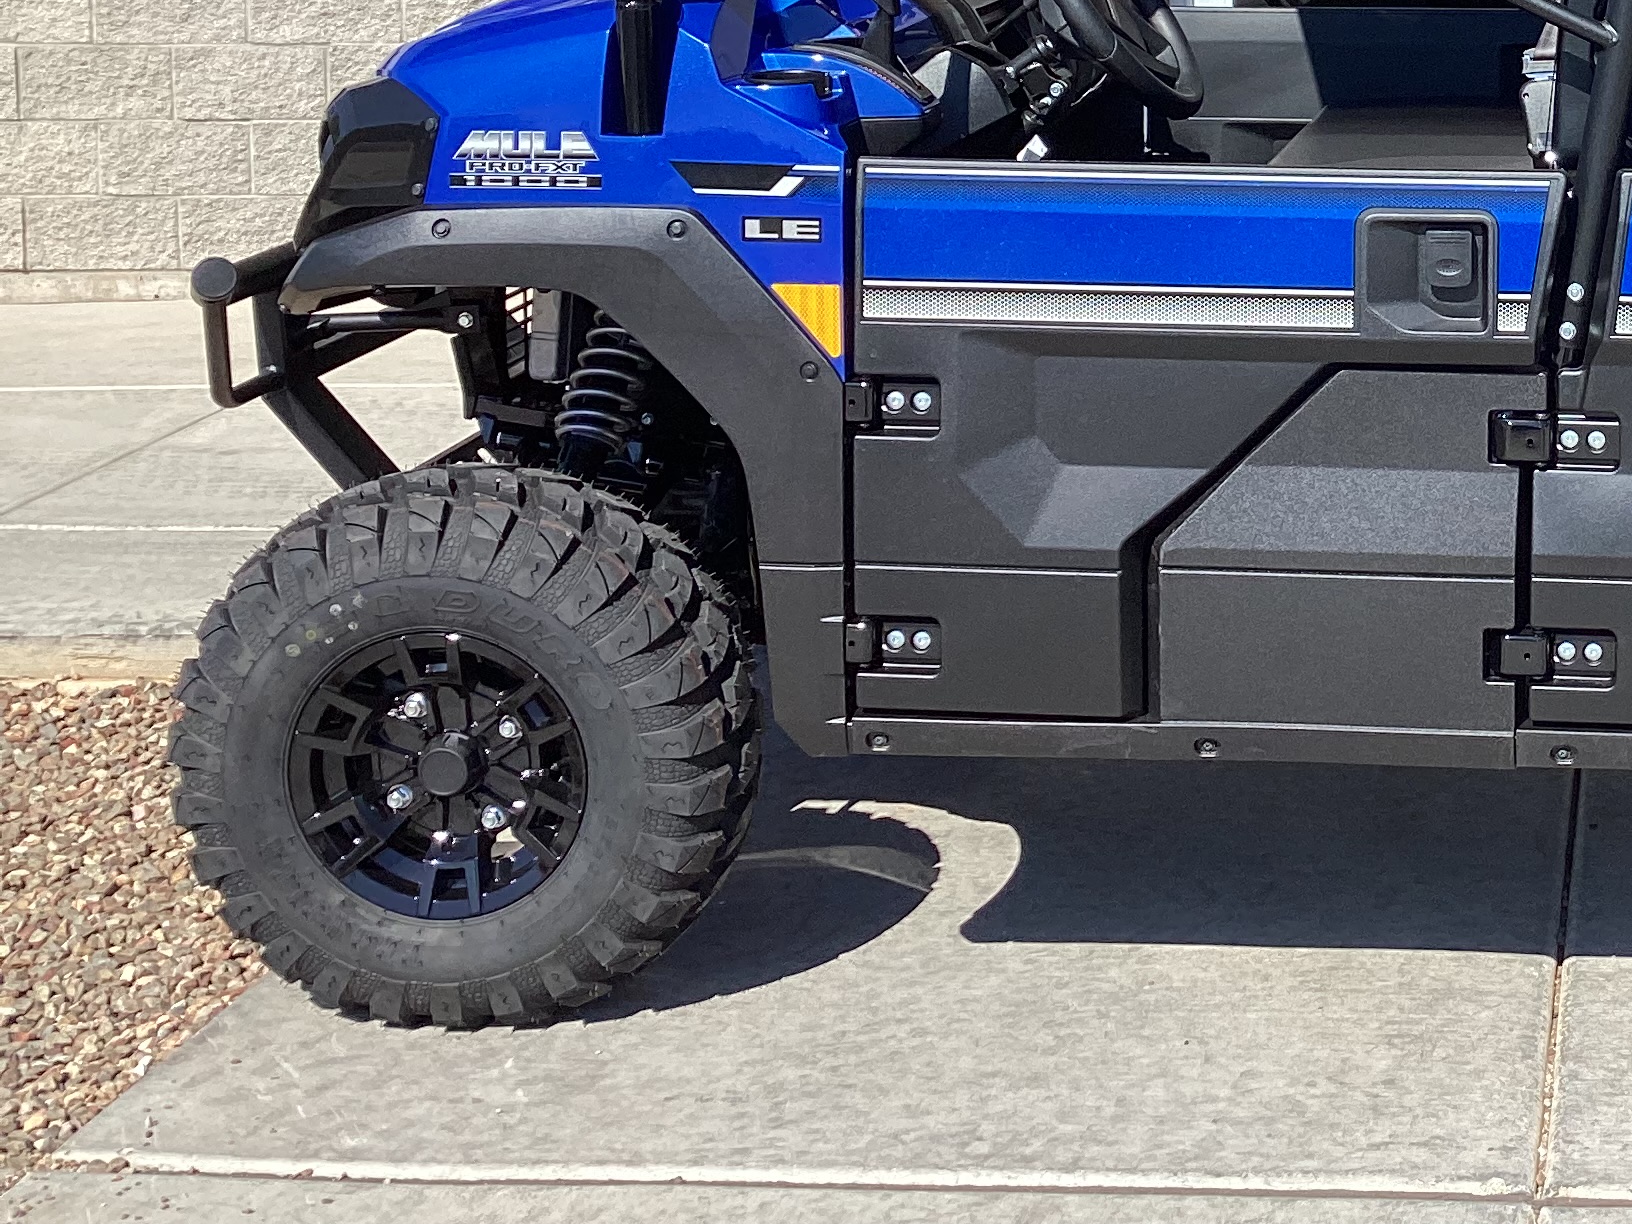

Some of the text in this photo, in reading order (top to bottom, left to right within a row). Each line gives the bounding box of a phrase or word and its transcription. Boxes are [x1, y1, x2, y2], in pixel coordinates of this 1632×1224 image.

[452, 129, 600, 161] MULE
[462, 175, 588, 188] 1000
[743, 218, 821, 240] LE
